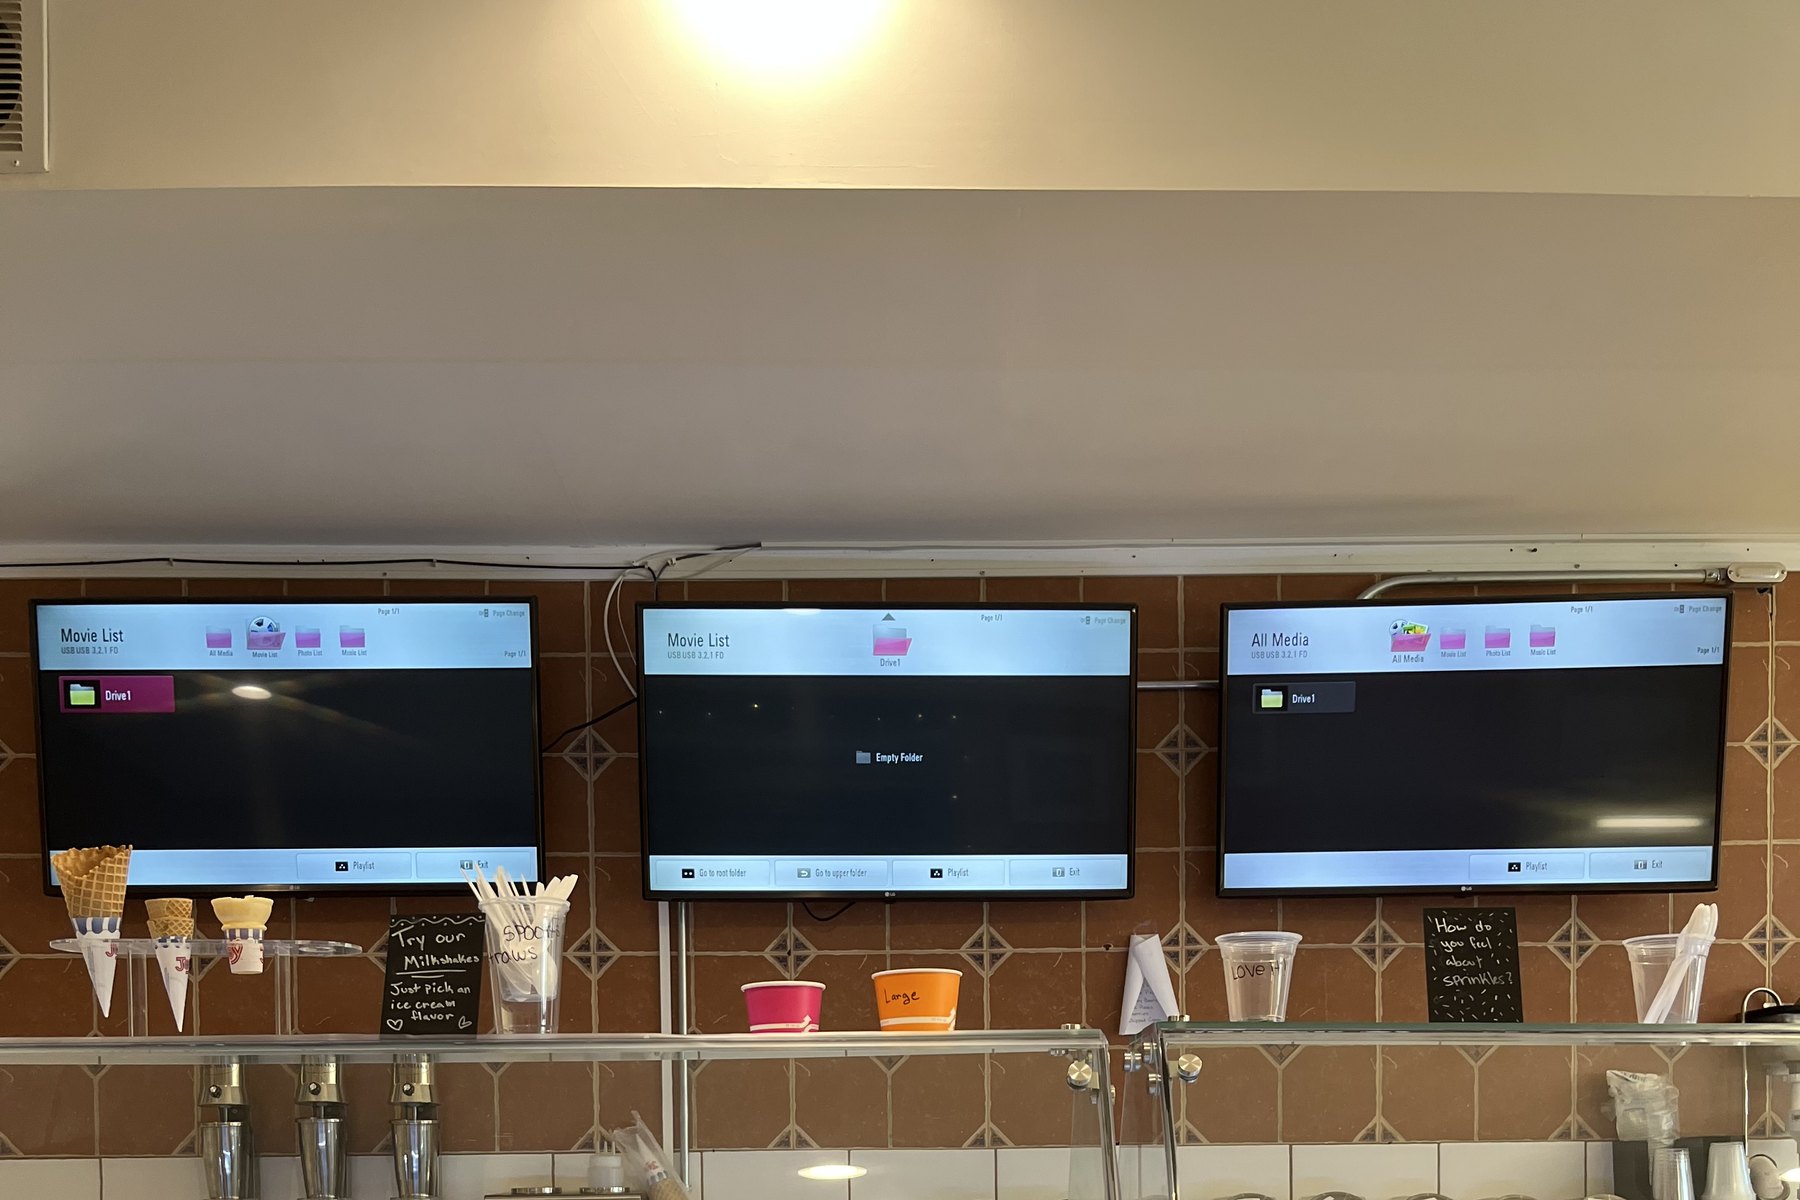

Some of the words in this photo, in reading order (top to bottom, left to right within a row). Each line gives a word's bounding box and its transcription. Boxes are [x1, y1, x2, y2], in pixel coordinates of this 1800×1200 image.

[61, 628, 98, 643] Movie
[102, 628, 124, 643] List
[668, 633, 704, 647] Movie
[708, 633, 730, 647] List
[1252, 633, 1268, 647] All
[1272, 632, 1309, 647] Media
[1697, 646, 1710, 654] Page
[1403, 654, 1424, 663] Media
[105, 690, 131, 701] Drive1
[1292, 693, 1316, 704] Drive1
[876, 752, 899, 764] Empty
[900, 752, 923, 763] Folder
[353, 861, 375, 871] Playlist
[477, 860, 489, 869] Exit
[1525, 861, 1548, 871] Playlist
[1651, 860, 1662, 869] Exit
[947, 867, 969, 878] Playlist
[1069, 867, 1080, 876] Exit
[1435, 918, 1467, 934] How
[1475, 919, 1492, 932] do
[391, 925, 426, 951] Try
[435, 933, 466, 943] our
[1440, 939, 1465, 952] you
[1469, 936, 1492, 951] feel
[404, 954, 480, 971] Milkshakes
[1445, 955, 1484, 969] about
[390, 982, 422, 996] Just
[457, 986, 471, 994] an
[884, 989, 920, 1005] Large
[391, 1001, 411, 1010] ice
[415, 1000, 456, 1009] cream
[411, 1011, 454, 1021] flavor
